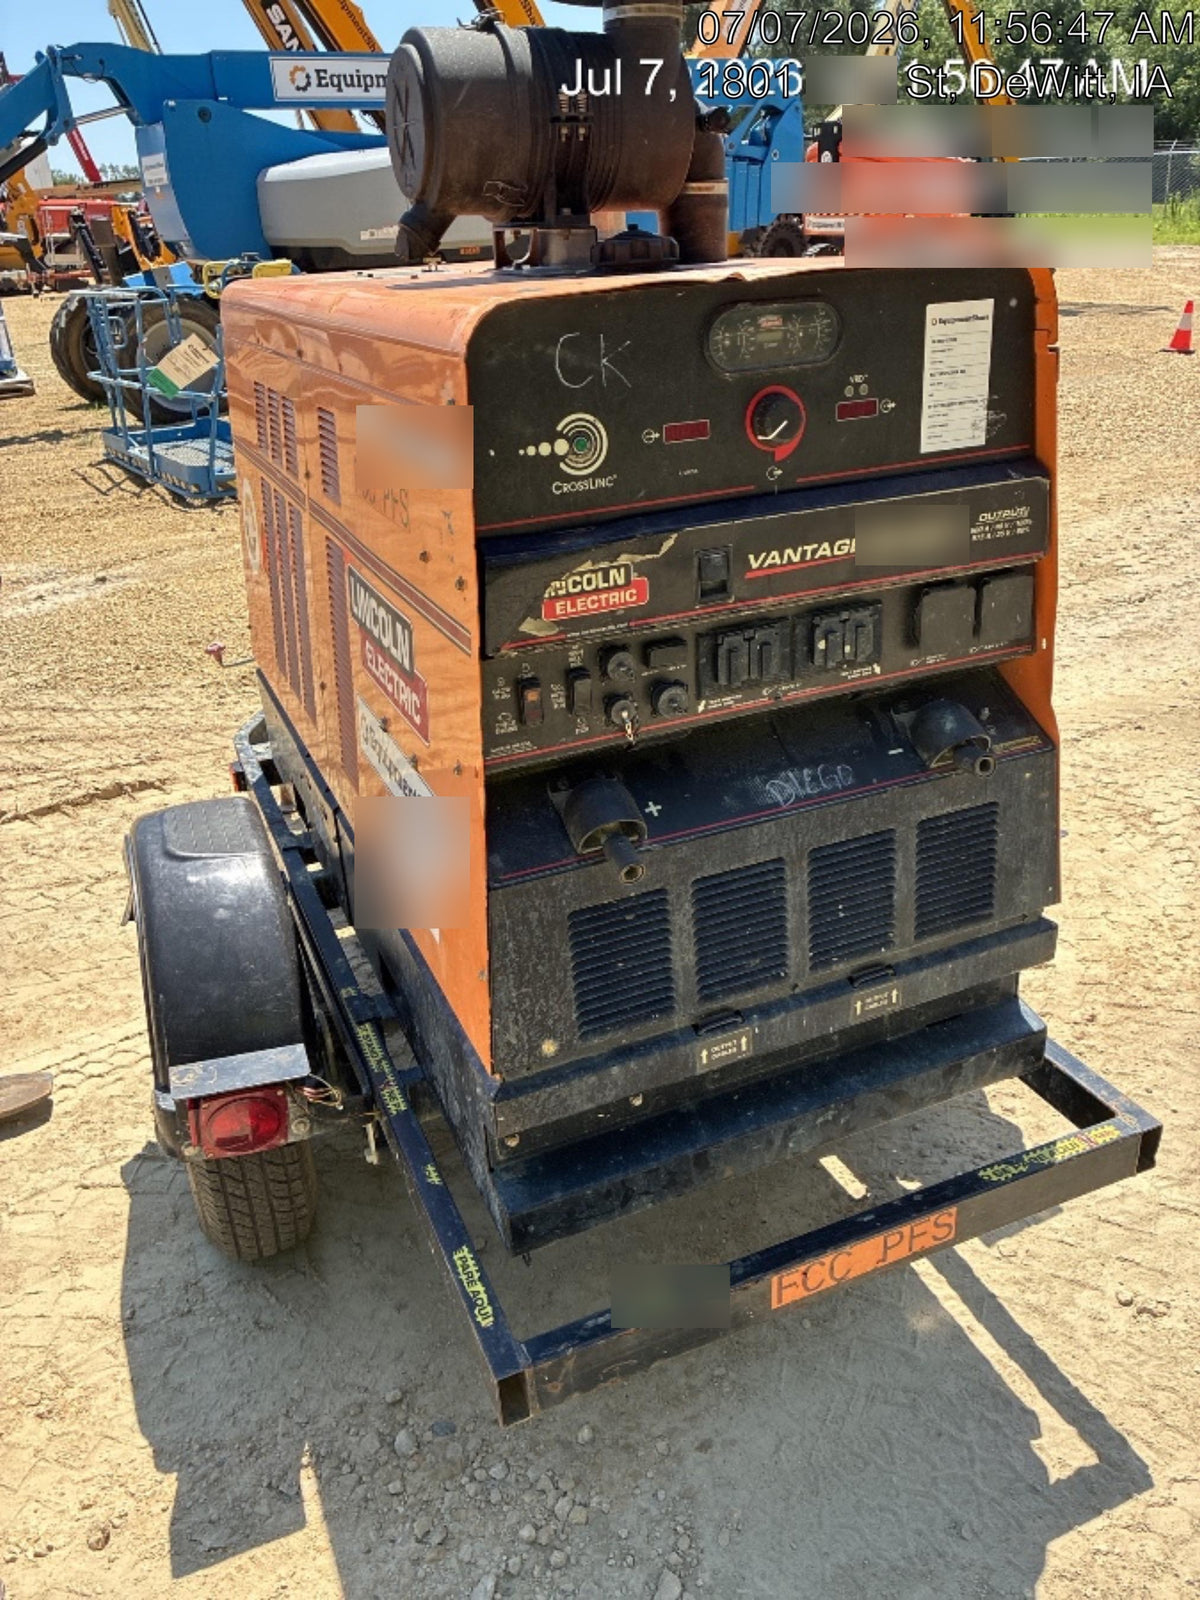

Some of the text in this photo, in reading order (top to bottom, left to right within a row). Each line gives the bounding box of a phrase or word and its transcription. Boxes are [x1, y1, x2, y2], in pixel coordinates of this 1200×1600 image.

[748, 536, 857, 570] VANTAG
[350, 576, 412, 672] LINCOLN
[555, 589, 638, 616] ELECTRIC
[365, 639, 422, 726] ELECTRIC
